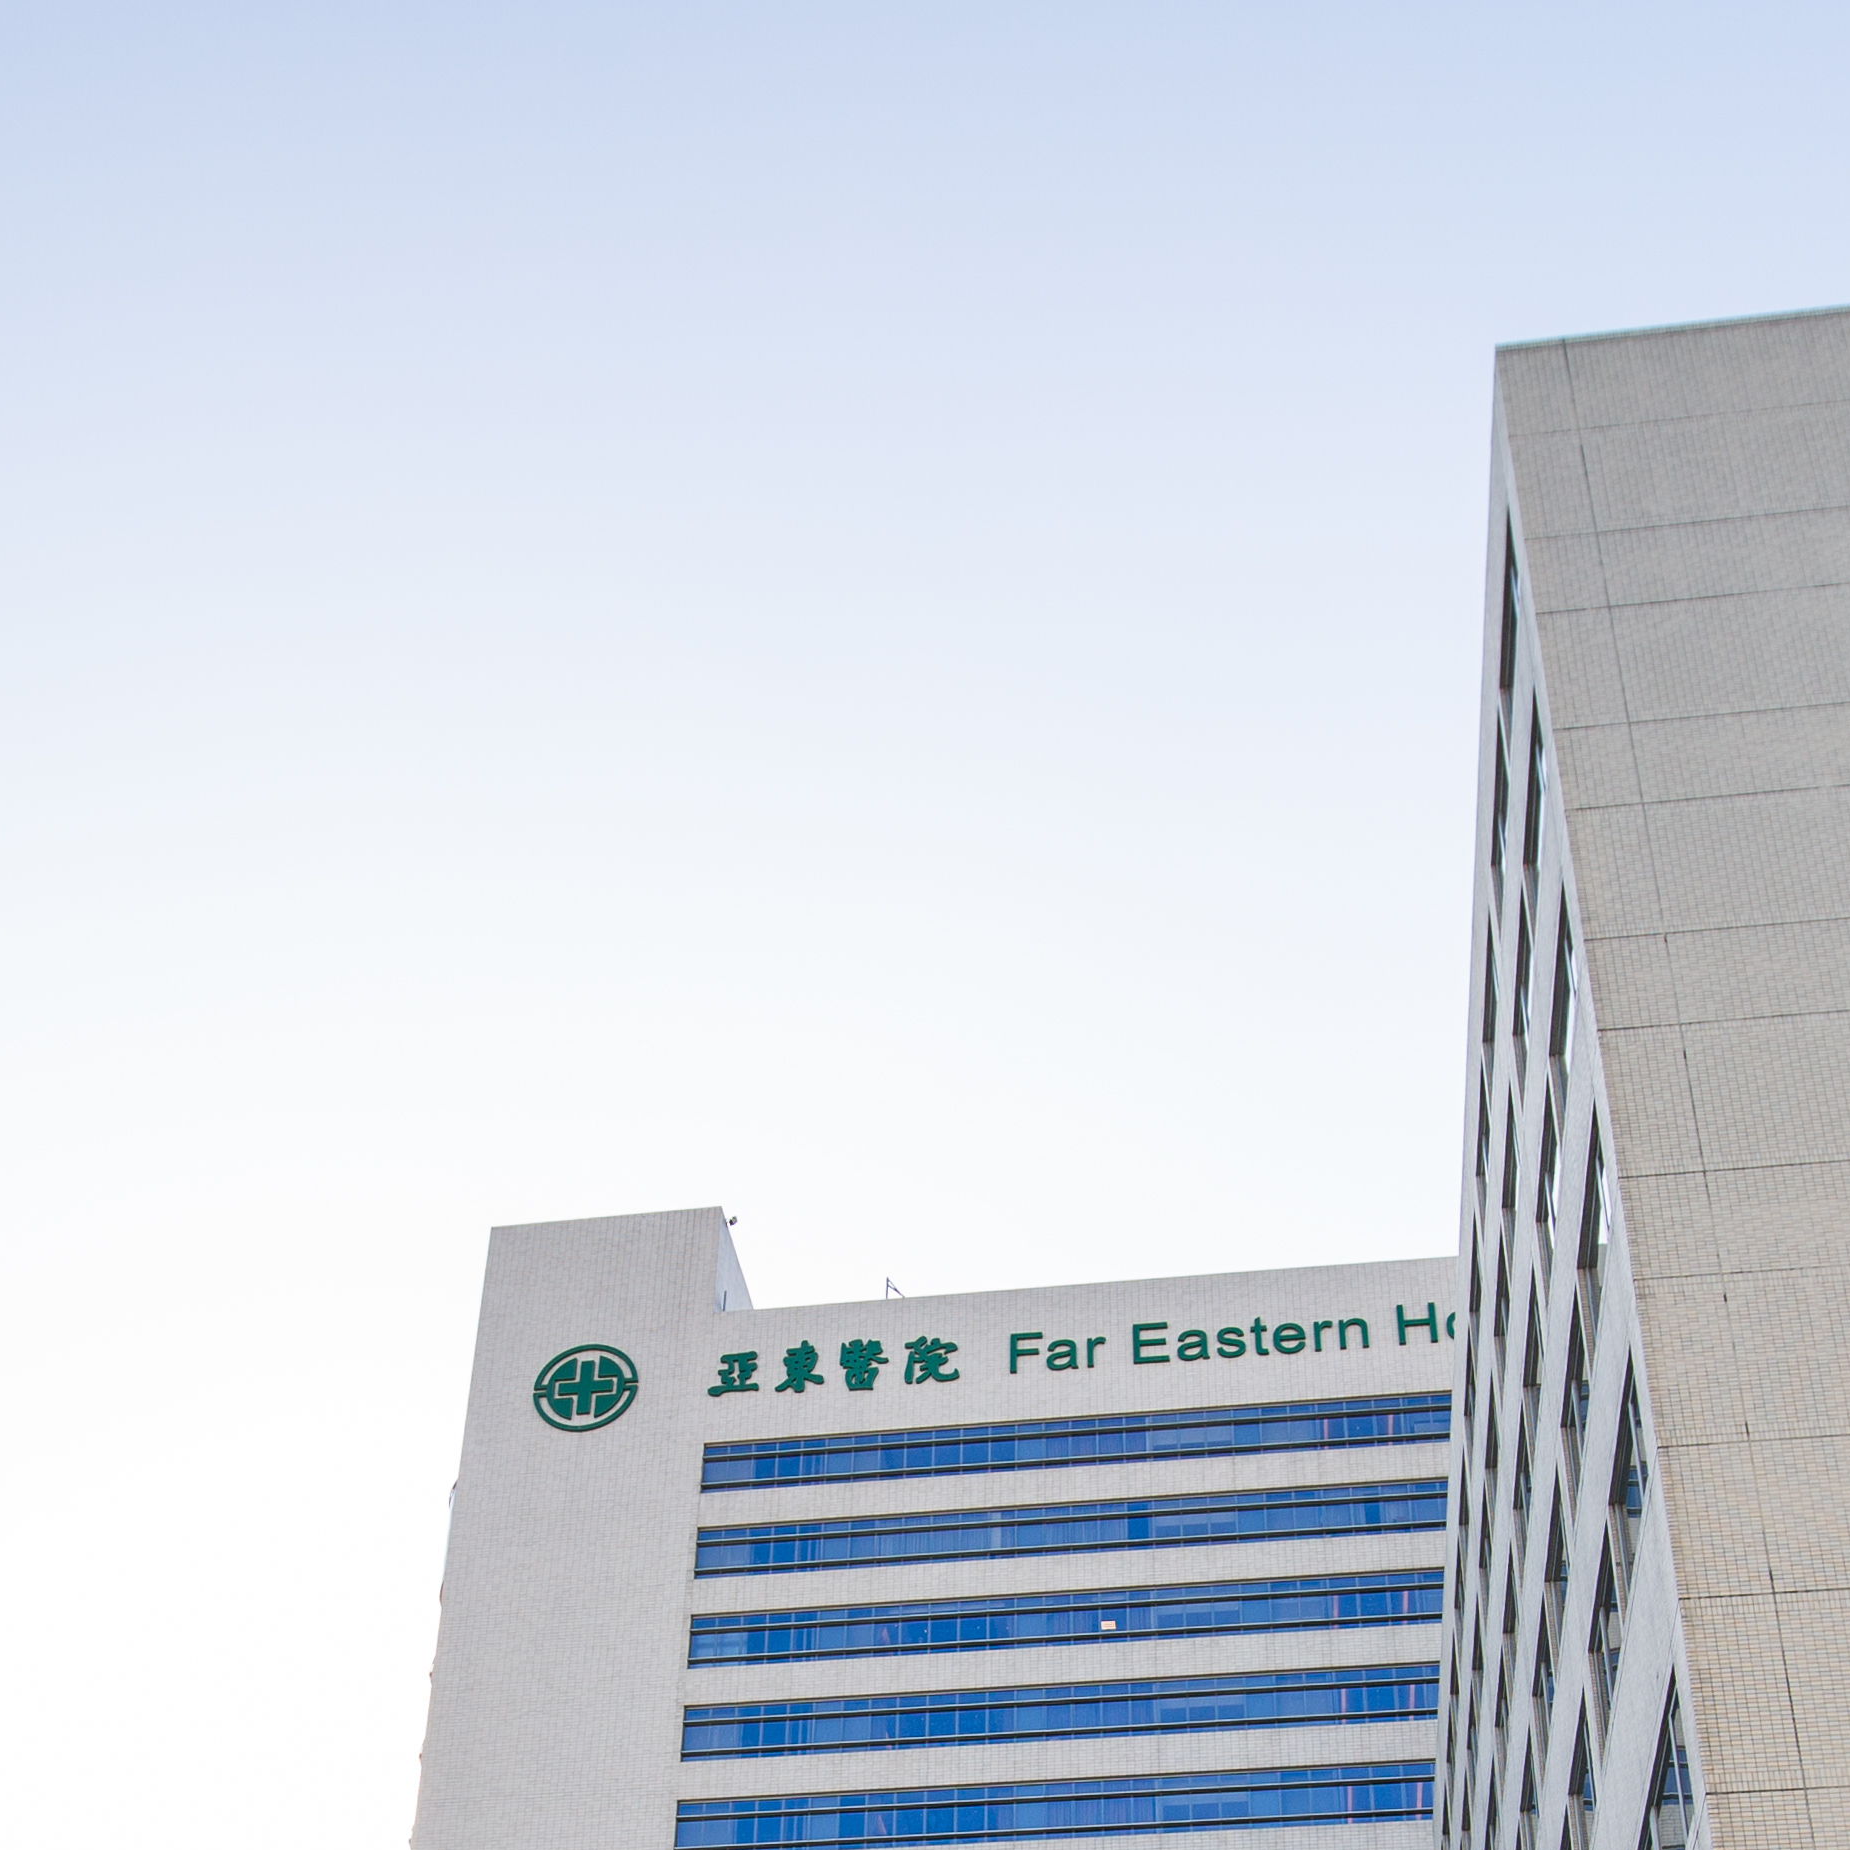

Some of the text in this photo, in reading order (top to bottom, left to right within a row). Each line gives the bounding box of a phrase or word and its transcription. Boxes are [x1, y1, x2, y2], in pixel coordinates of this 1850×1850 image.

[708, 1335, 961, 1397] 亞東醫院
[1010, 1331, 1107, 1374] Far
[1133, 1317, 1371, 1365] Eastern
